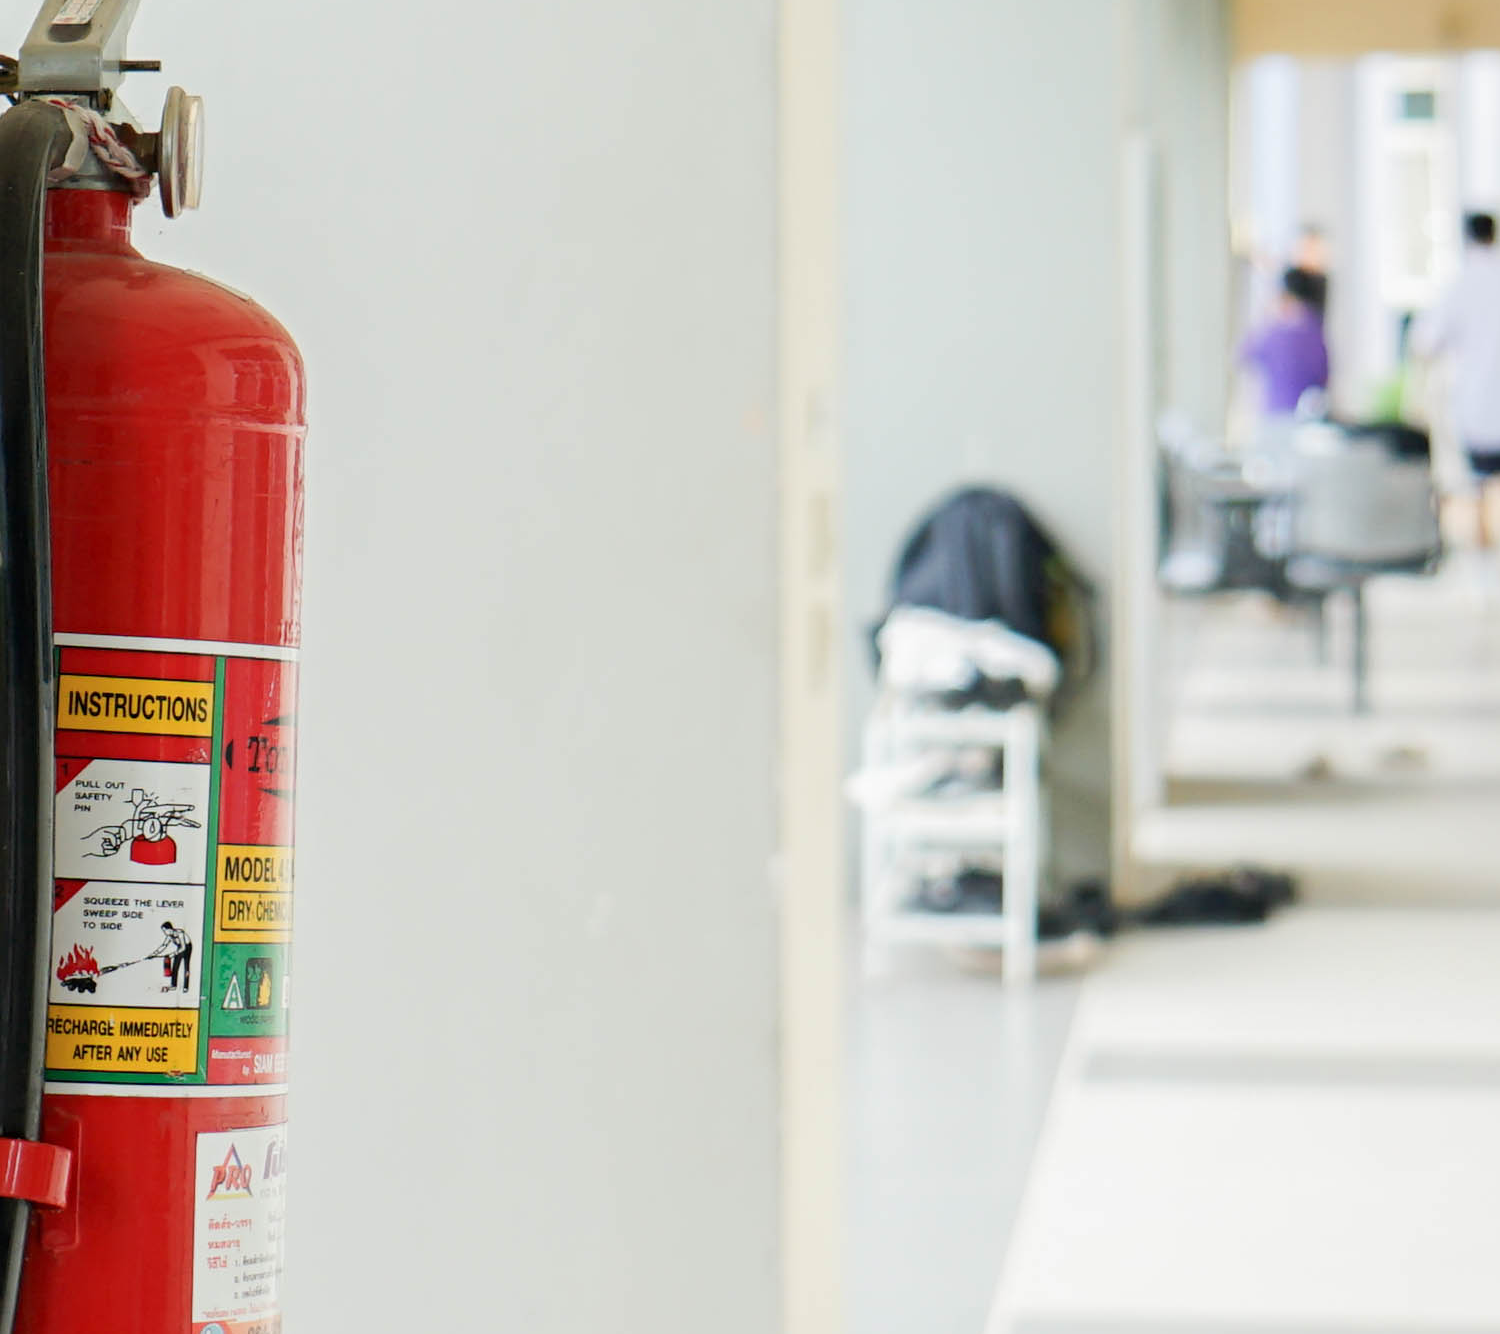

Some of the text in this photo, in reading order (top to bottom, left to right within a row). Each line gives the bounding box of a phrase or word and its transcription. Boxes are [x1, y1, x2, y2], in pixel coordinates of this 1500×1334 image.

[68, 690, 208, 723] INSTRUCTIONS
[62, 763, 69, 776] 1
[74, 779, 126, 790] PULL OUT
[73, 792, 113, 801] SAFETY
[73, 803, 91, 813] PIN
[224, 855, 276, 883] MODEL
[83, 897, 185, 909] SQUEEZE THE LEVER
[83, 909, 144, 919] SWEEP SIDE
[228, 899, 253, 922] DRY
[83, 921, 123, 931] TO SIDE
[47, 1017, 193, 1039] RECHARGE IMMEDIATELY
[72, 1044, 169, 1063] AFTER ANY USE
